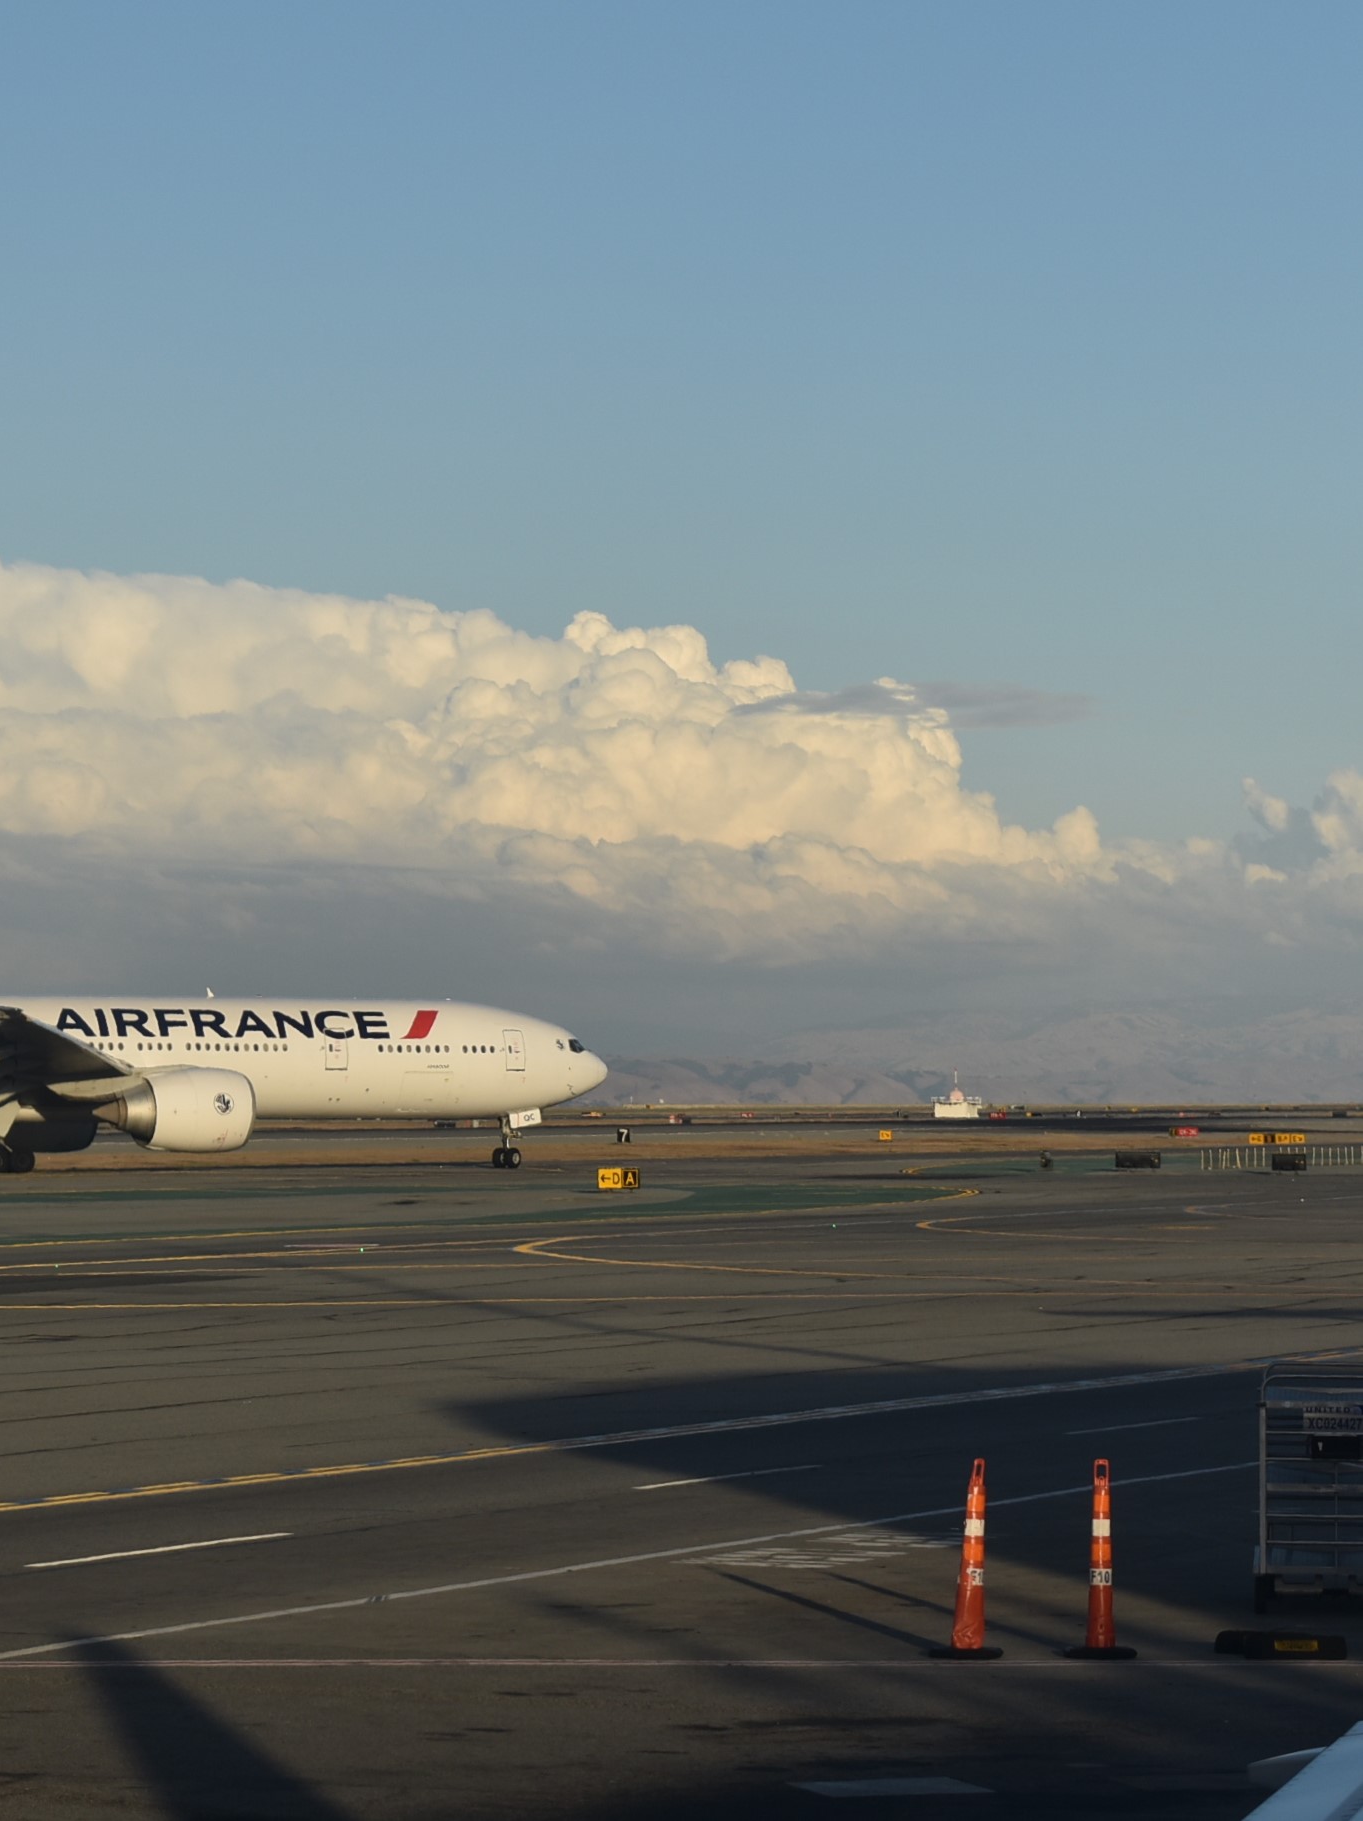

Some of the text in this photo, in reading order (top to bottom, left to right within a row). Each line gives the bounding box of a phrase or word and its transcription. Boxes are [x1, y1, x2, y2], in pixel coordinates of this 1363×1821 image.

[55, 1008, 391, 1040] AIRFRANCE
[523, 1113, 535, 1122] QC
[618, 1128, 628, 1143] 7
[612, 1172, 635, 1185] D A
[1090, 1570, 1111, 1584] F10
